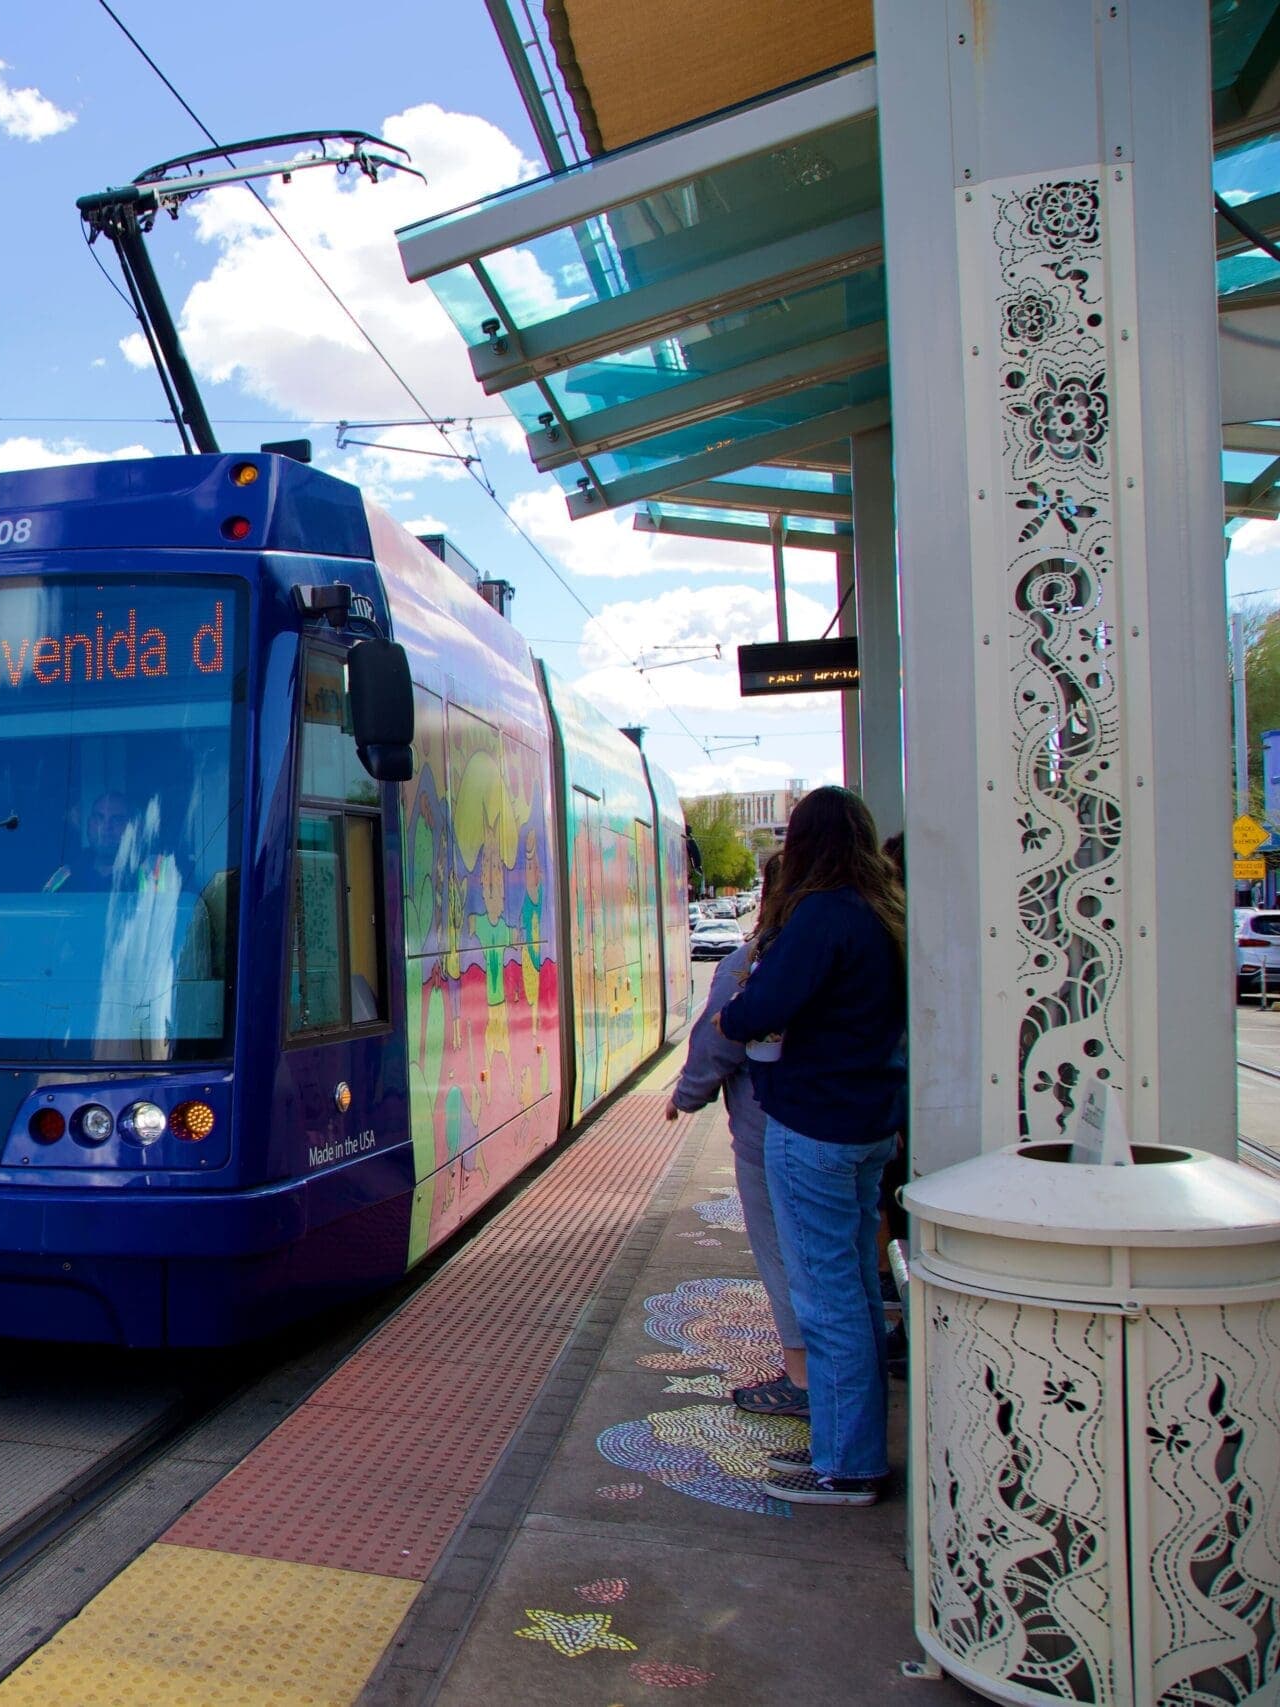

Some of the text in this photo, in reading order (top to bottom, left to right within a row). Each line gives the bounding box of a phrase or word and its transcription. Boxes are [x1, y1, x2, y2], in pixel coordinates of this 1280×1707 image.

[193, 601, 224, 673] d
[309, 1129, 376, 1167] Made in the USA
